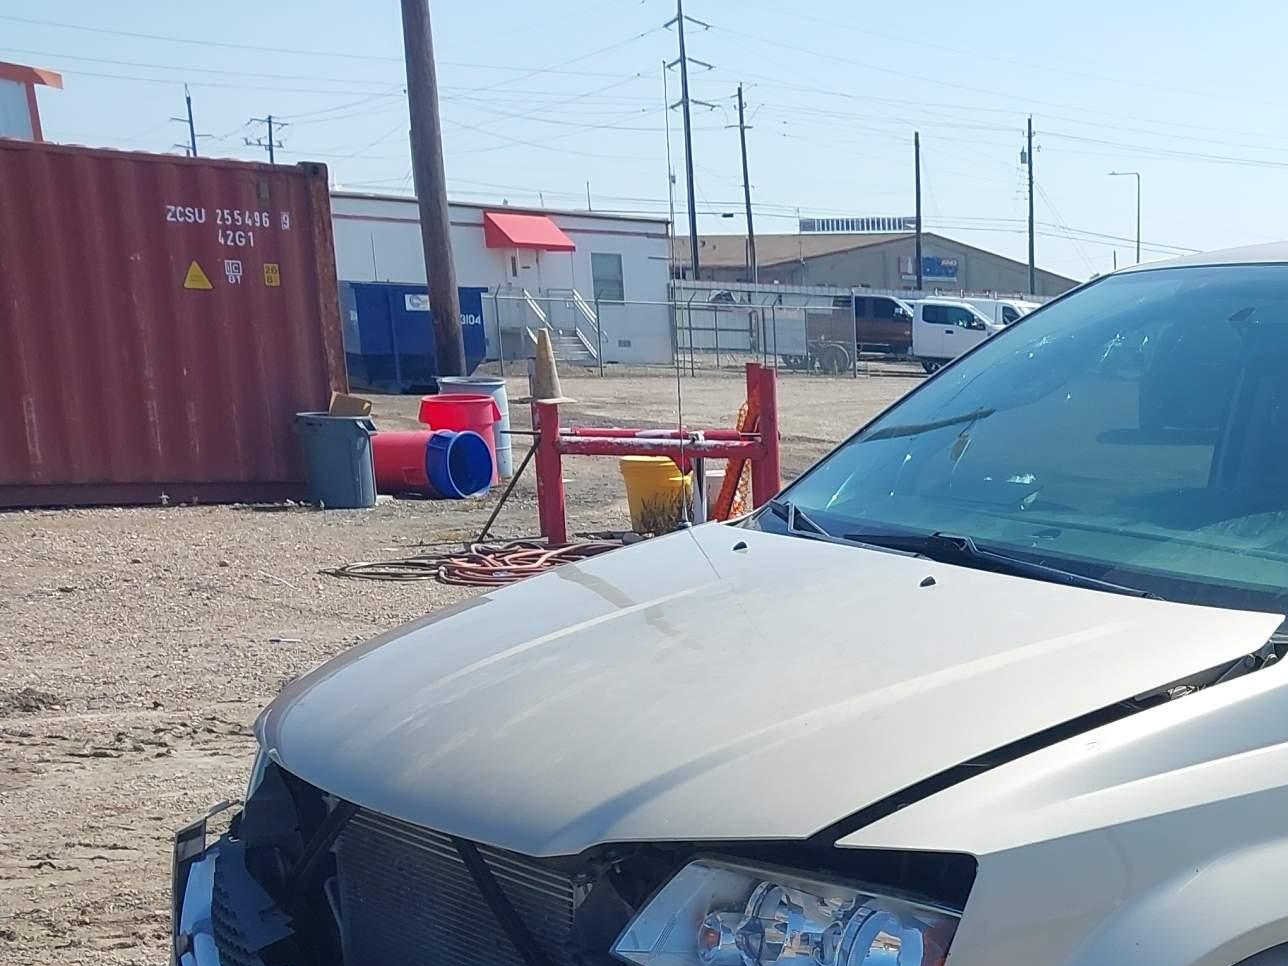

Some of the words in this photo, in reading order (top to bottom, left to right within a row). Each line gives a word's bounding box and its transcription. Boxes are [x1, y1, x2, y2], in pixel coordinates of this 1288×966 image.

[165, 205, 206, 224] ZCSU
[216, 208, 270, 228] 255496
[281, 211, 290, 229] 9
[217, 230, 255, 247] 42G1
